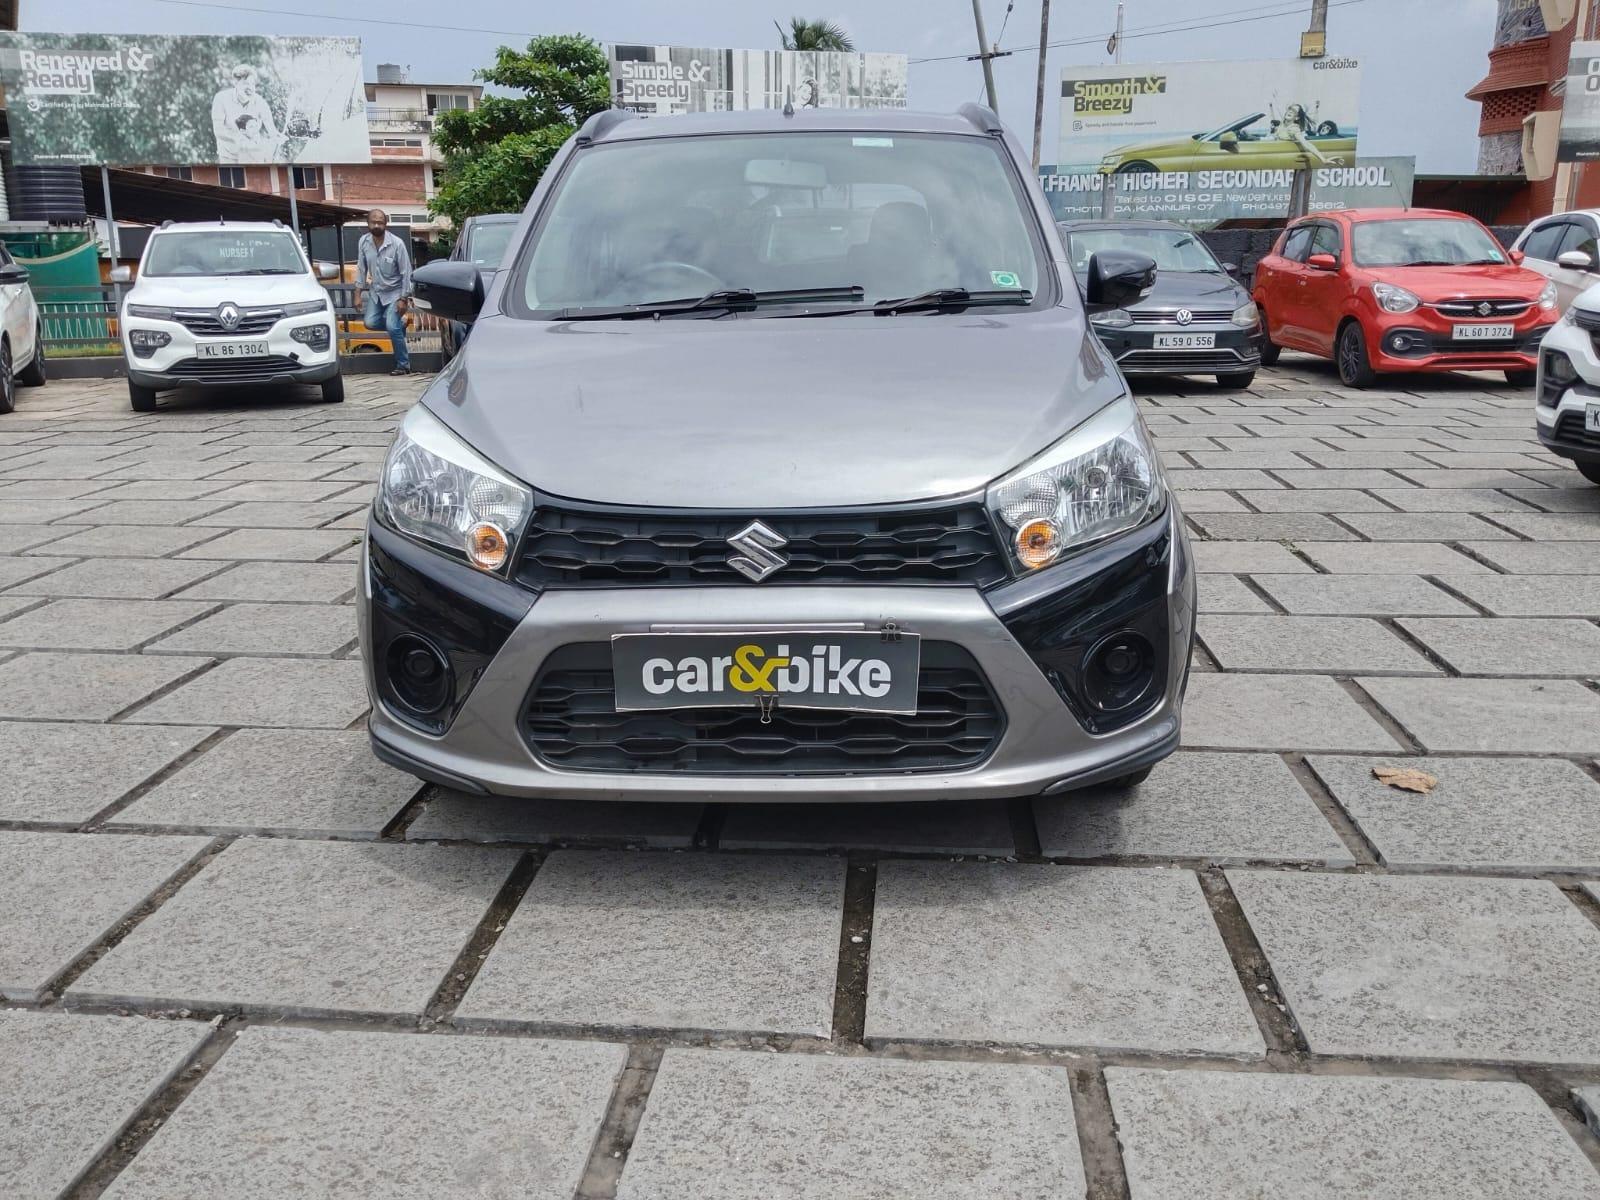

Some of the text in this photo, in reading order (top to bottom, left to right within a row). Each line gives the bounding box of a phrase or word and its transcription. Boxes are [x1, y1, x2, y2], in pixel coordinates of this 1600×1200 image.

[20, 46, 153, 71] Renewed &
[1313, 58, 1358, 70] car&bike
[24, 70, 92, 94] Ready
[622, 59, 711, 82] Simple &
[623, 80, 689, 103] Speedy
[1073, 74, 1166, 98] Smooth &
[1073, 96, 1133, 114] Breezy
[1123, 171, 1189, 191] HIGHER
[1198, 168, 1295, 189] SECONDAR
[1316, 166, 1392, 187] SCHOOL
[1150, 194, 1162, 203] to
[1159, 337, 1170, 347] KL
[1173, 337, 1184, 347] 59
[1195, 336, 1212, 346] 556
[1459, 327, 1513, 337] KL 60 T 3724
[205, 343, 264, 356] KL 86 1304
[642, 644, 892, 698] car&bike
